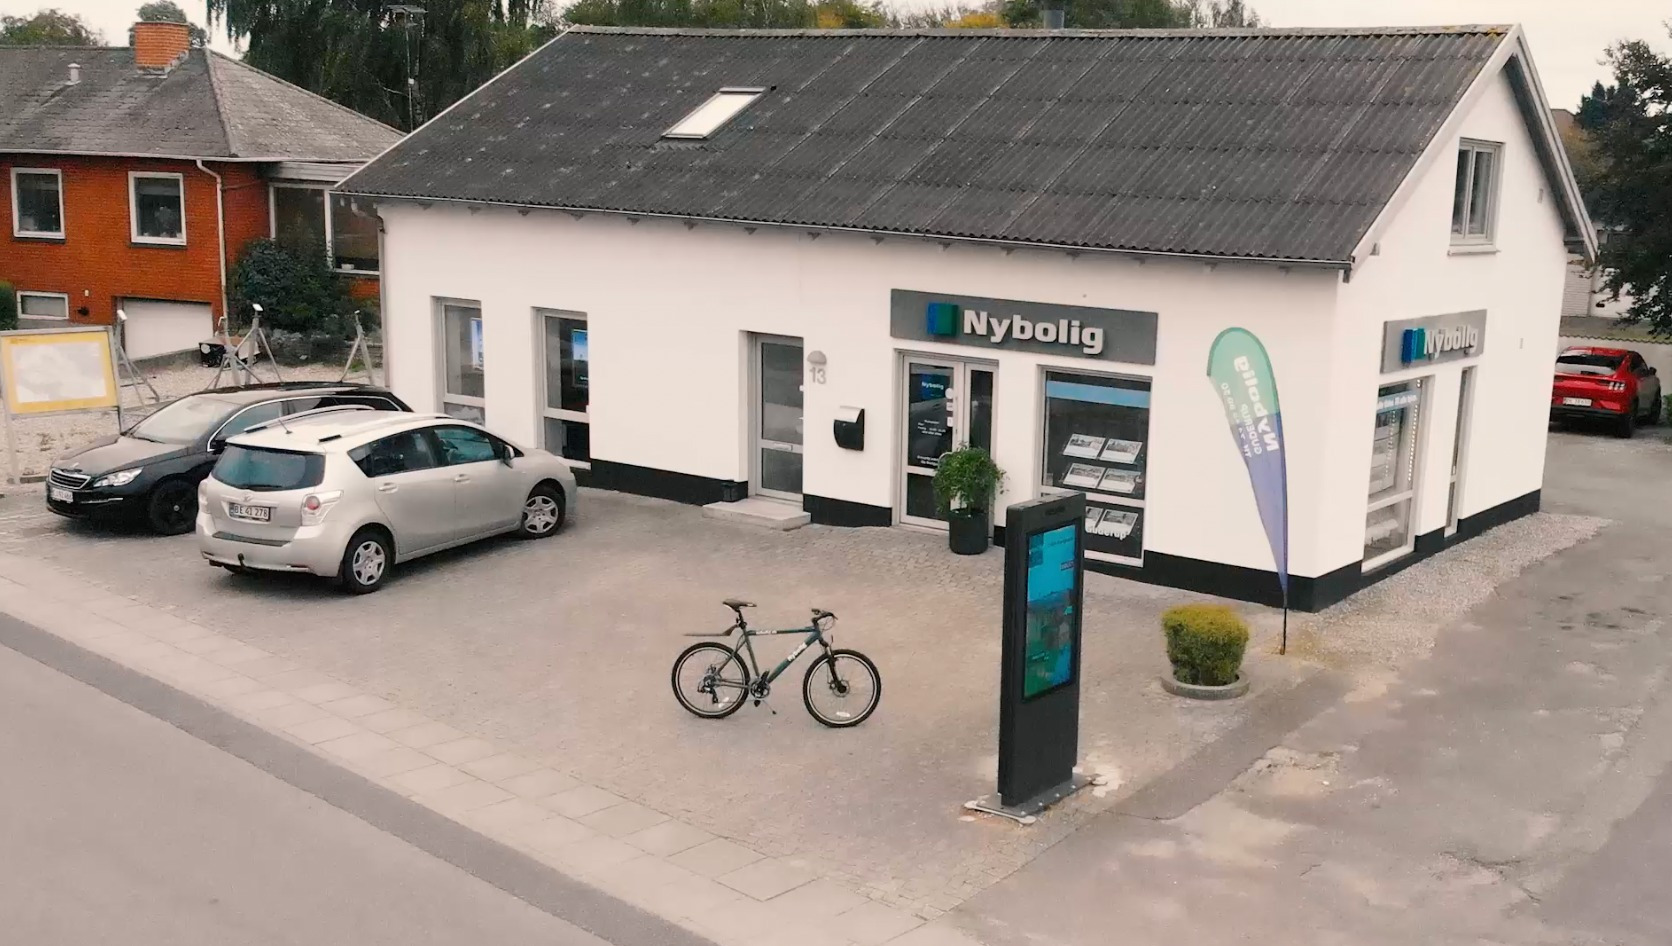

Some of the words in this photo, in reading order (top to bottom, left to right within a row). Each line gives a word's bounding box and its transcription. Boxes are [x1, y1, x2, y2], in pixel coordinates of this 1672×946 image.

[963, 309, 1104, 355] Nybolig
[1424, 326, 1478, 359] Nybolig
[809, 366, 826, 384] 13
